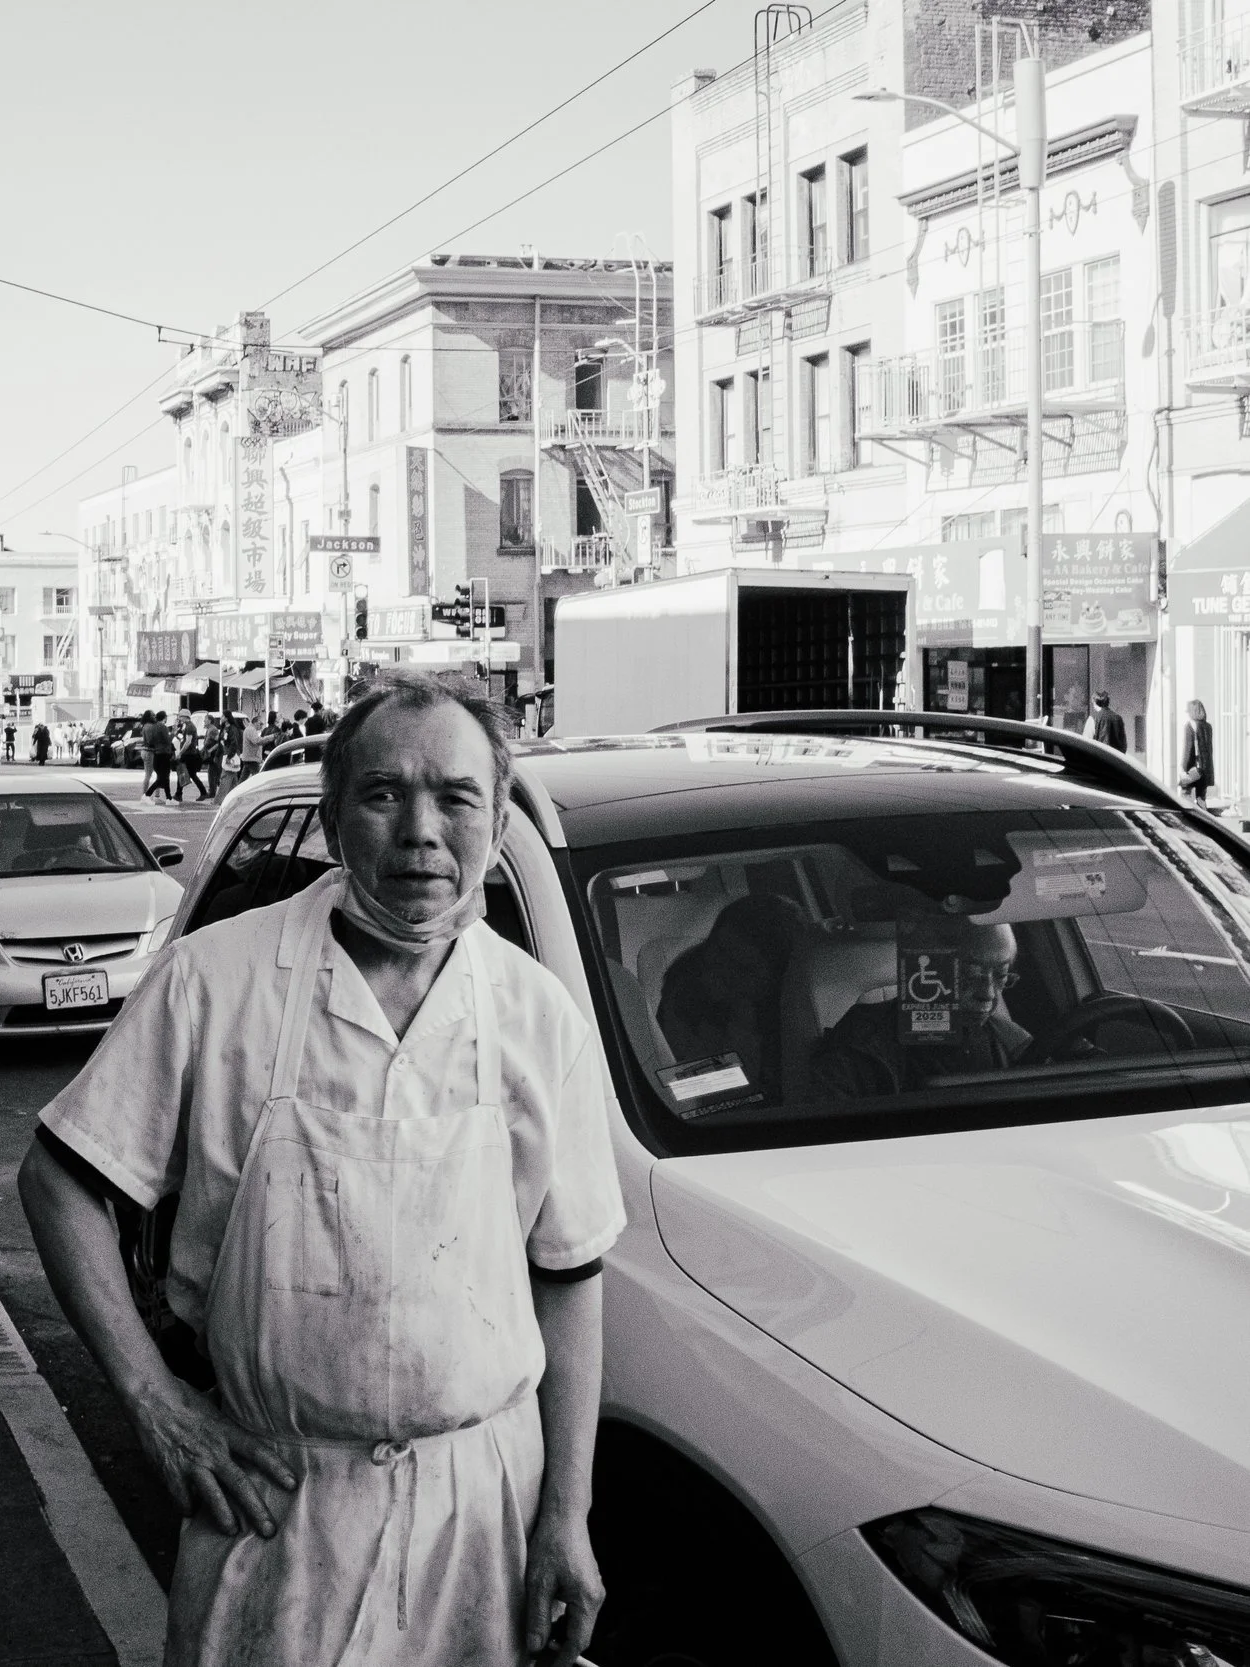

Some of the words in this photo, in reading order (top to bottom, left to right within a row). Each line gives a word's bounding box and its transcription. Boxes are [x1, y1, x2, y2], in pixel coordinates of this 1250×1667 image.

[317, 539, 374, 550] Jackson
[1051, 539, 1134, 561] 永興餅家
[1071, 564, 1110, 577] Bakery
[1112, 564, 1122, 574] &
[1124, 563, 1149, 573] Cafe
[936, 593, 964, 611] Cafe
[1192, 597, 1228, 614] TUNE
[386, 611, 415, 635] FOCUS
[50, 985, 104, 1005] 5JKF561
[916, 1012, 944, 1020] 2025
